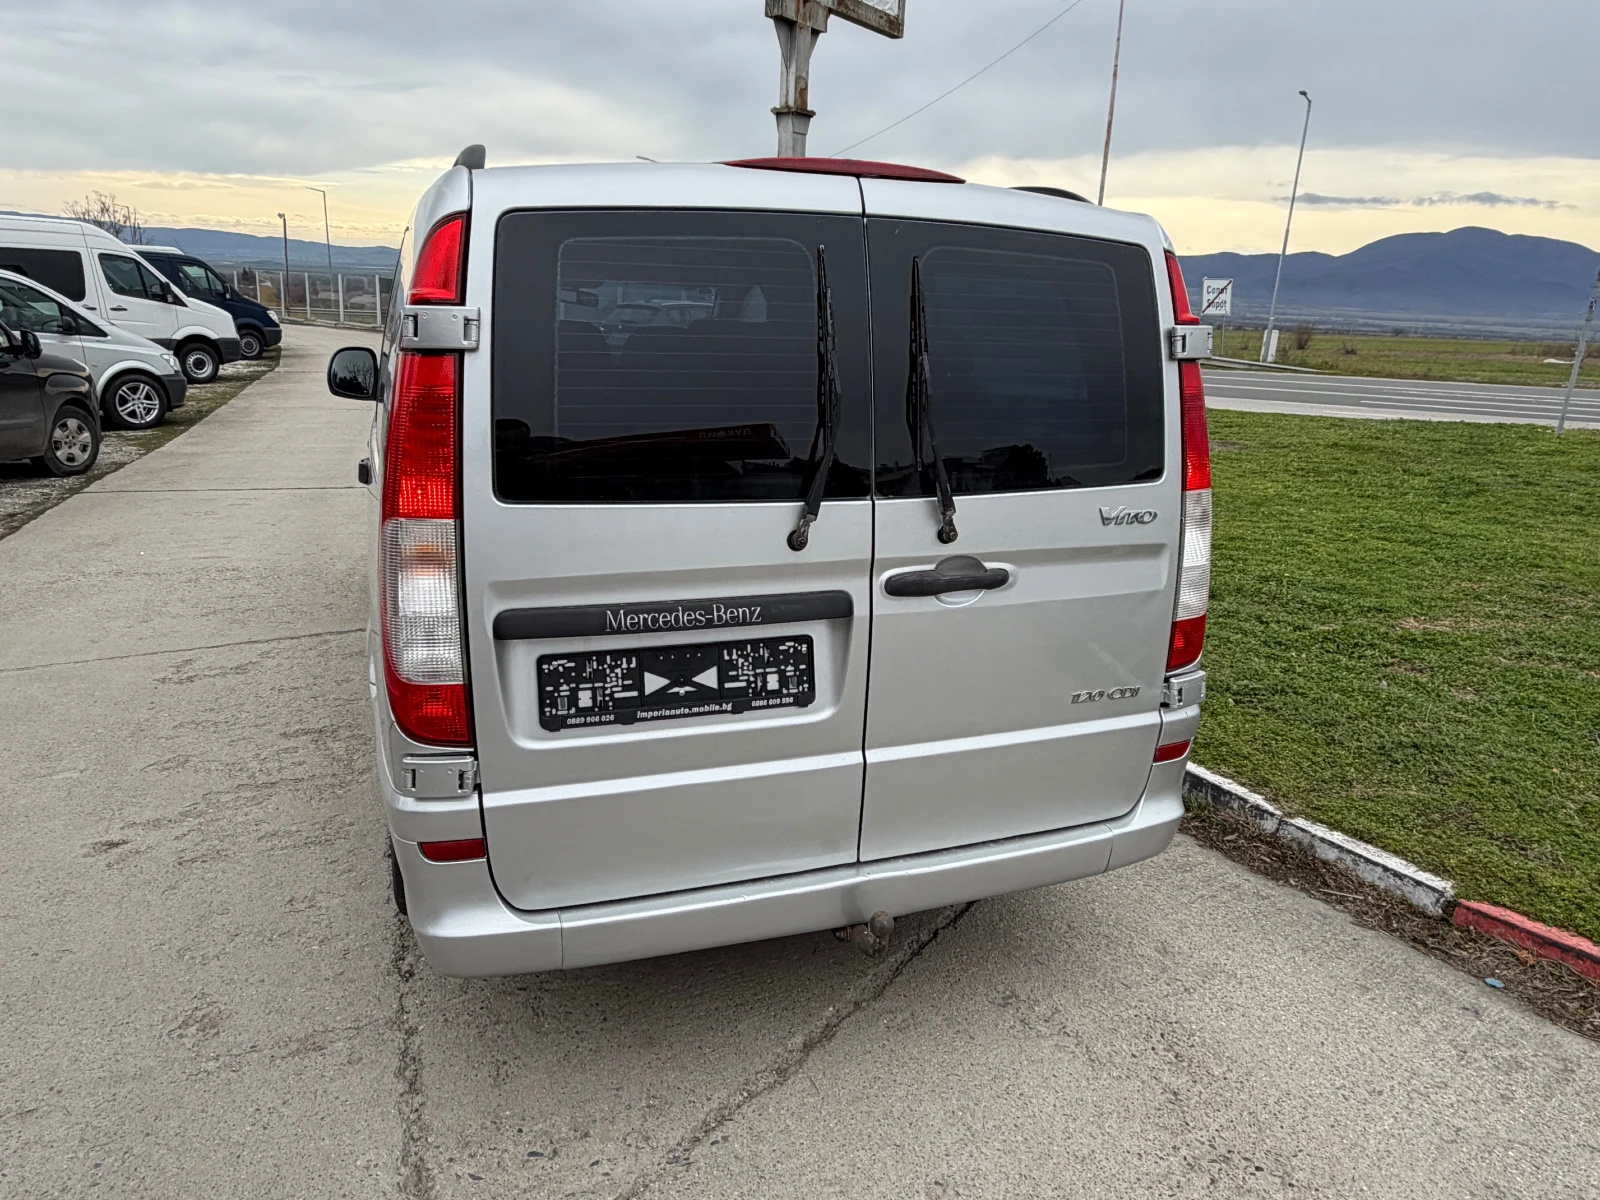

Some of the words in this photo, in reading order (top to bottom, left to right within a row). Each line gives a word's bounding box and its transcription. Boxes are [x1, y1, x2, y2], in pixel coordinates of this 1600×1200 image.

[605, 603, 762, 632] Mercedes-Benz
[1071, 690, 1105, 704] 120
[1107, 685, 1141, 700] CDI
